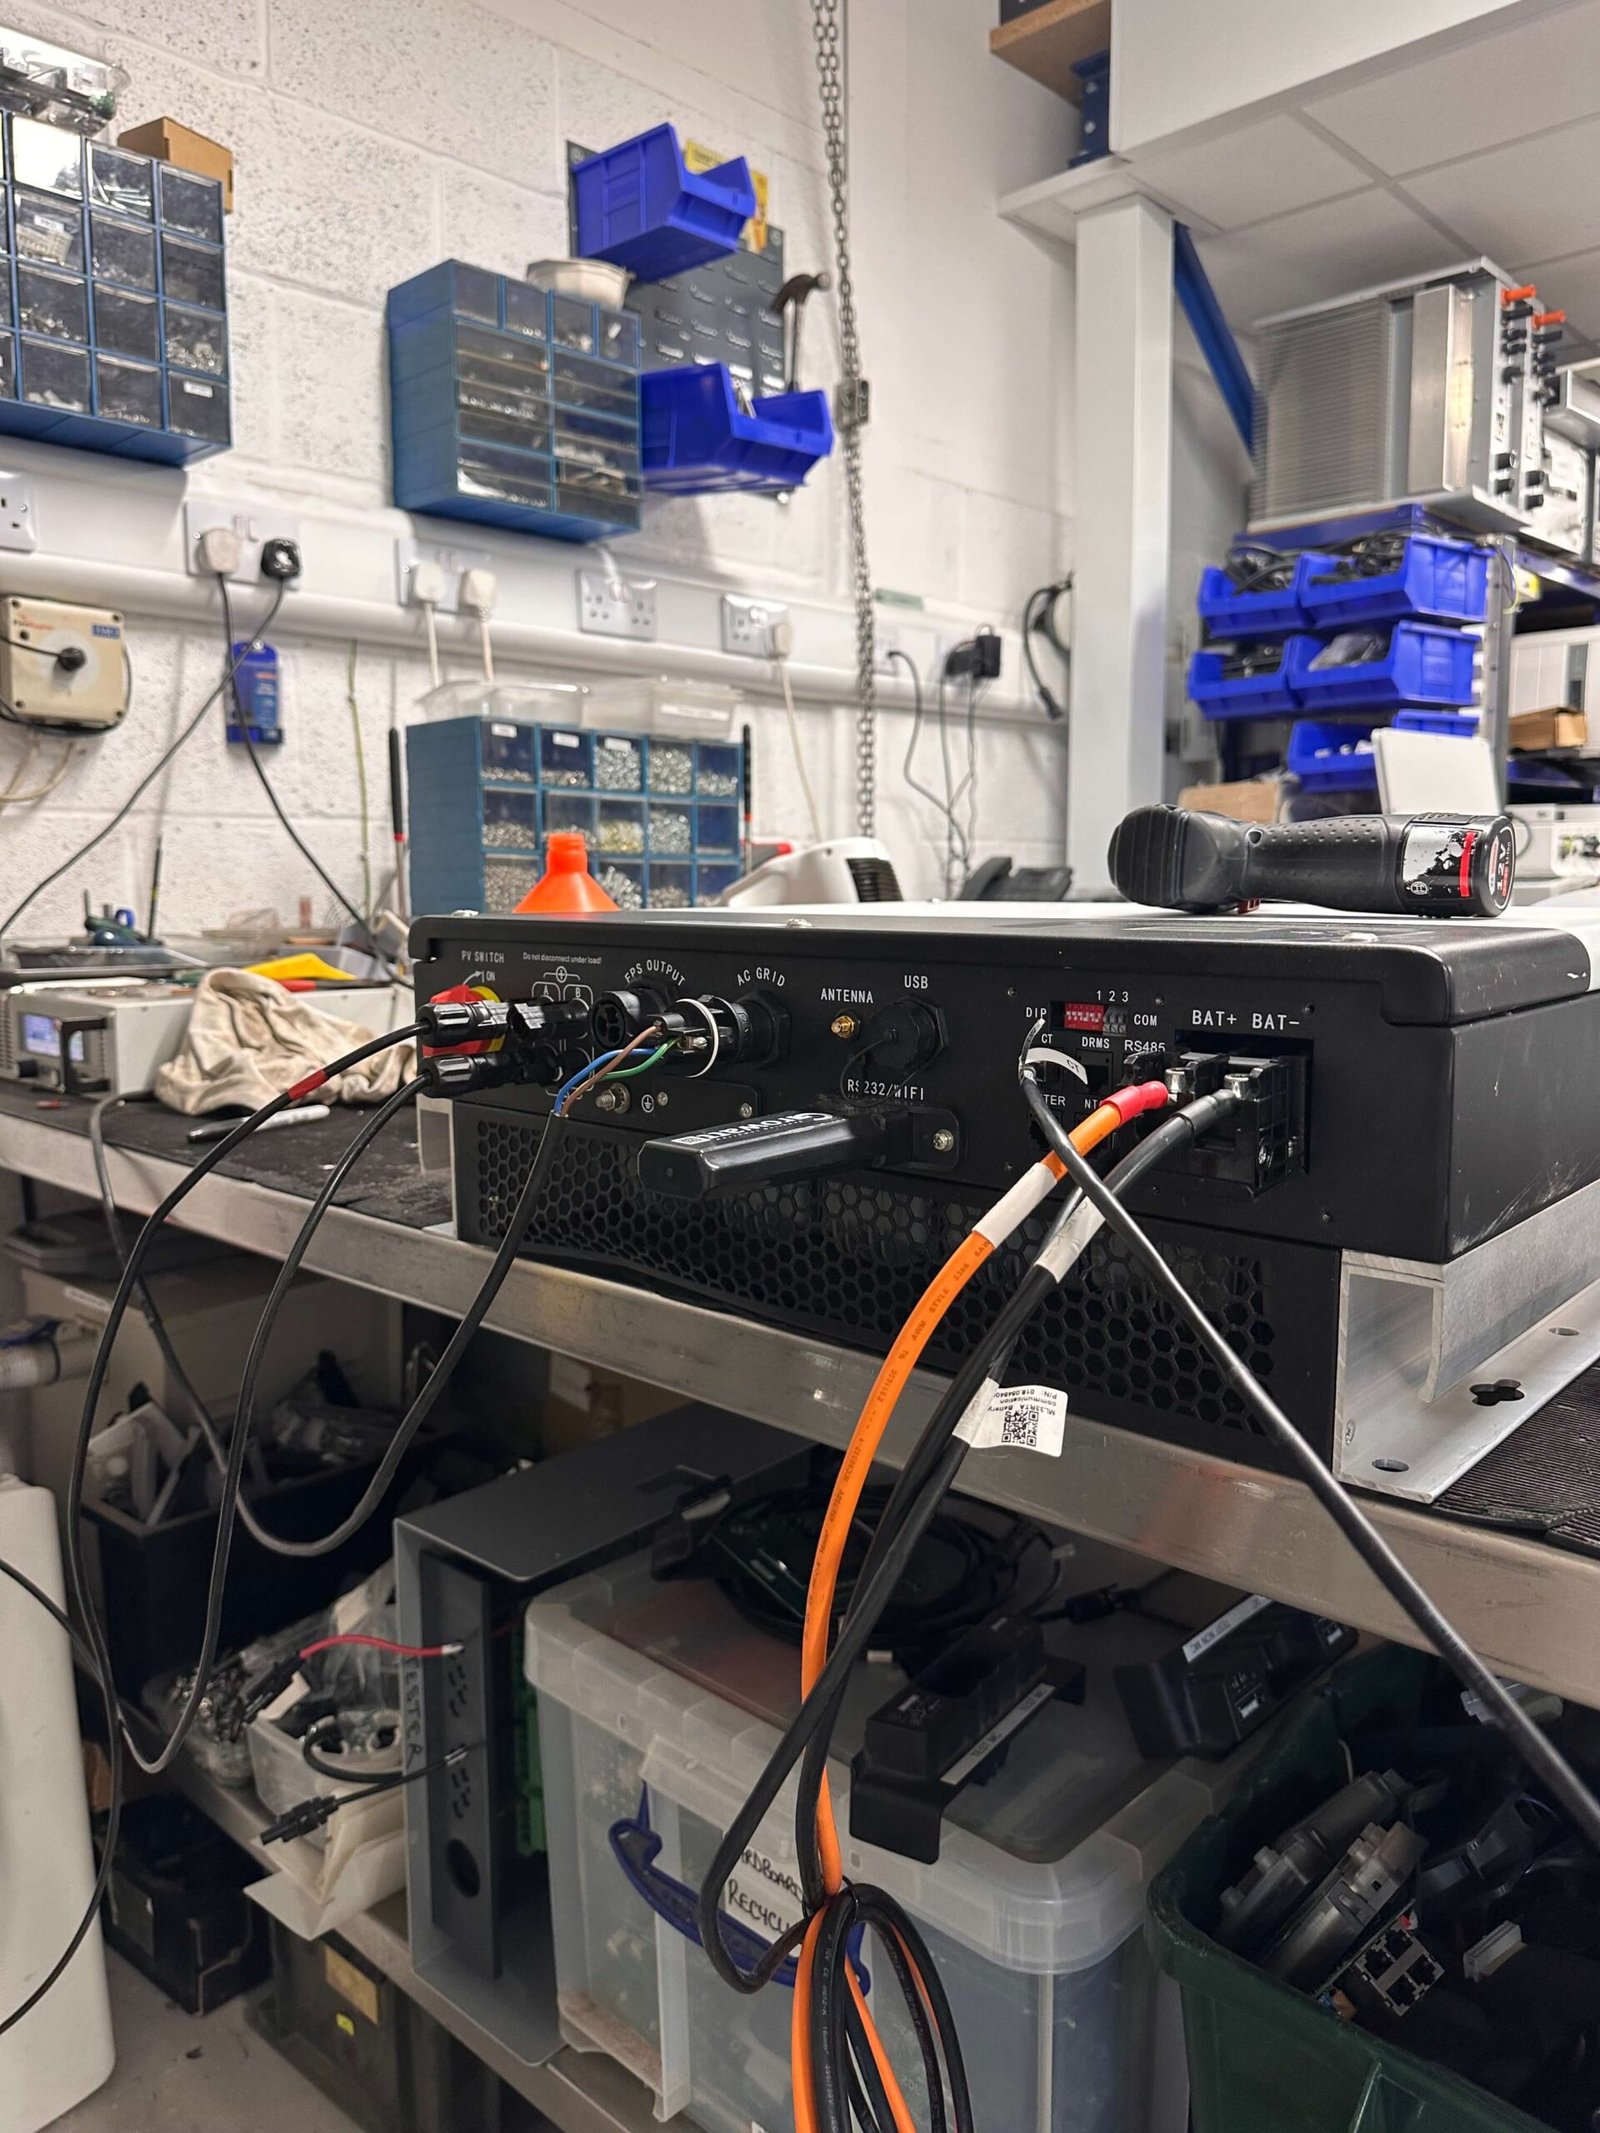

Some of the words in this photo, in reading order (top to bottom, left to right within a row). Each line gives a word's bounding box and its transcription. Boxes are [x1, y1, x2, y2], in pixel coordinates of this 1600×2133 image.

[461, 950, 472, 961] PV
[474, 951, 505, 964] SWITCH
[523, 951, 532, 961] Do
[532, 952, 541, 961] not
[541, 952, 570, 963] disconnect
[570, 955, 587, 964] under
[485, 970, 496, 981] ON
[646, 959, 686, 986] OUTPUT
[737, 969, 751, 986] AC
[755, 966, 786, 987] GRID
[904, 975, 929, 989] USB
[543, 984, 550, 996] A
[575, 986, 581, 998] B
[820, 987, 874, 1004] ANTENNA
[1096, 990, 1102, 1001] 1
[1108, 990, 1116, 1002] 2
[1121, 991, 1129, 1003] 3
[1026, 1007, 1048, 1018] DIP
[1133, 1014, 1158, 1026] COM
[1192, 1009, 1238, 1027] BAT+
[1252, 1012, 1300, 1031] BAT-
[1041, 1033, 1053, 1044] CT
[1081, 1036, 1110, 1049] DRMS
[1124, 1039, 1166, 1053] RS485
[1067, 1059, 1080, 1074] CT
[1041, 1093, 1067, 1107] TER
[1084, 1098, 1099, 1110] NT
[929, 1288, 951, 1313] STYLE
[987, 1404, 1014, 1412] Battery
[999, 1397, 1057, 1407] communication
